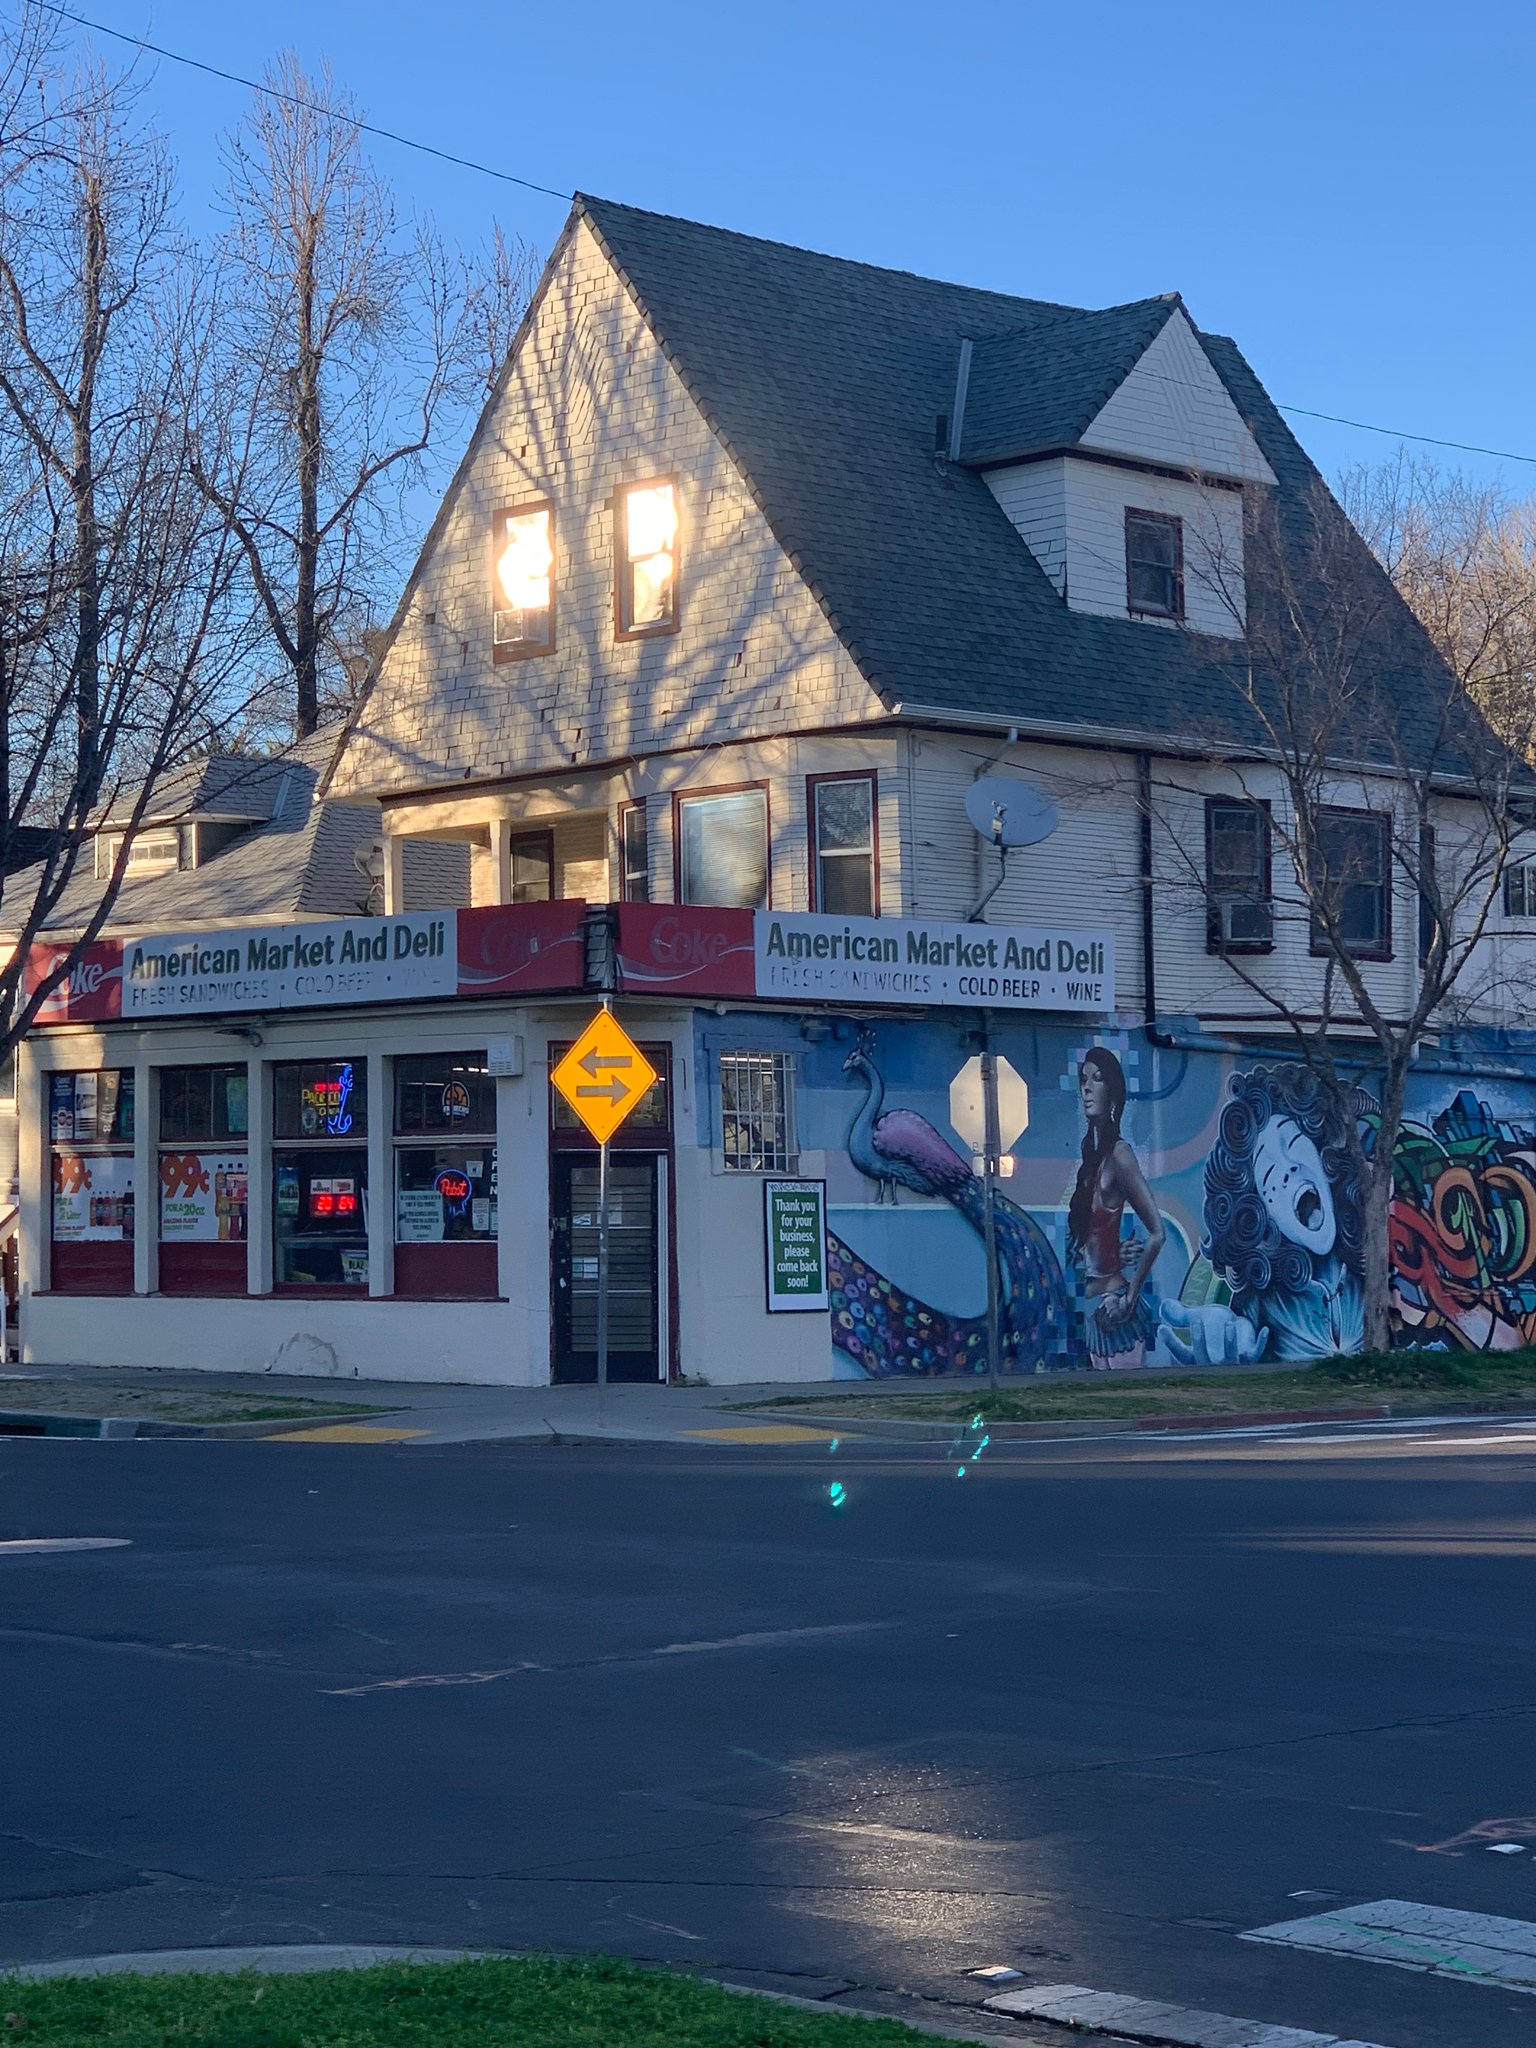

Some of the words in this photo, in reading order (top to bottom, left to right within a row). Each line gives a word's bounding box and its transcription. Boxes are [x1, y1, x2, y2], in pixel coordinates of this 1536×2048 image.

[653, 916, 727, 965] Coke
[767, 922, 899, 962] American
[906, 931, 998, 969] Market
[1003, 936, 1050, 971] And
[1057, 940, 1104, 975] Deli
[129, 943, 240, 981] American
[247, 934, 335, 972] Market
[339, 926, 388, 964] And
[394, 922, 444, 960] Deli
[132, 984, 175, 1007] FRESH
[180, 977, 269, 1004] SANDWICHES
[294, 974, 335, 996] COLD
[958, 976, 999, 996] COLD
[1002, 978, 1040, 998] BEER
[1066, 981, 1102, 1001] WINE
[440, 1178, 467, 1196] Pabst
[775, 1198, 800, 1212] Thank
[801, 1201, 816, 1215] you
[781, 1214, 793, 1227] for
[795, 1216, 813, 1230] your
[780, 1229, 815, 1243] business,
[784, 1244, 810, 1260] please
[777, 1262, 798, 1273] come
[799, 1260, 818, 1273] back
[787, 1274, 809, 1288] soon!
